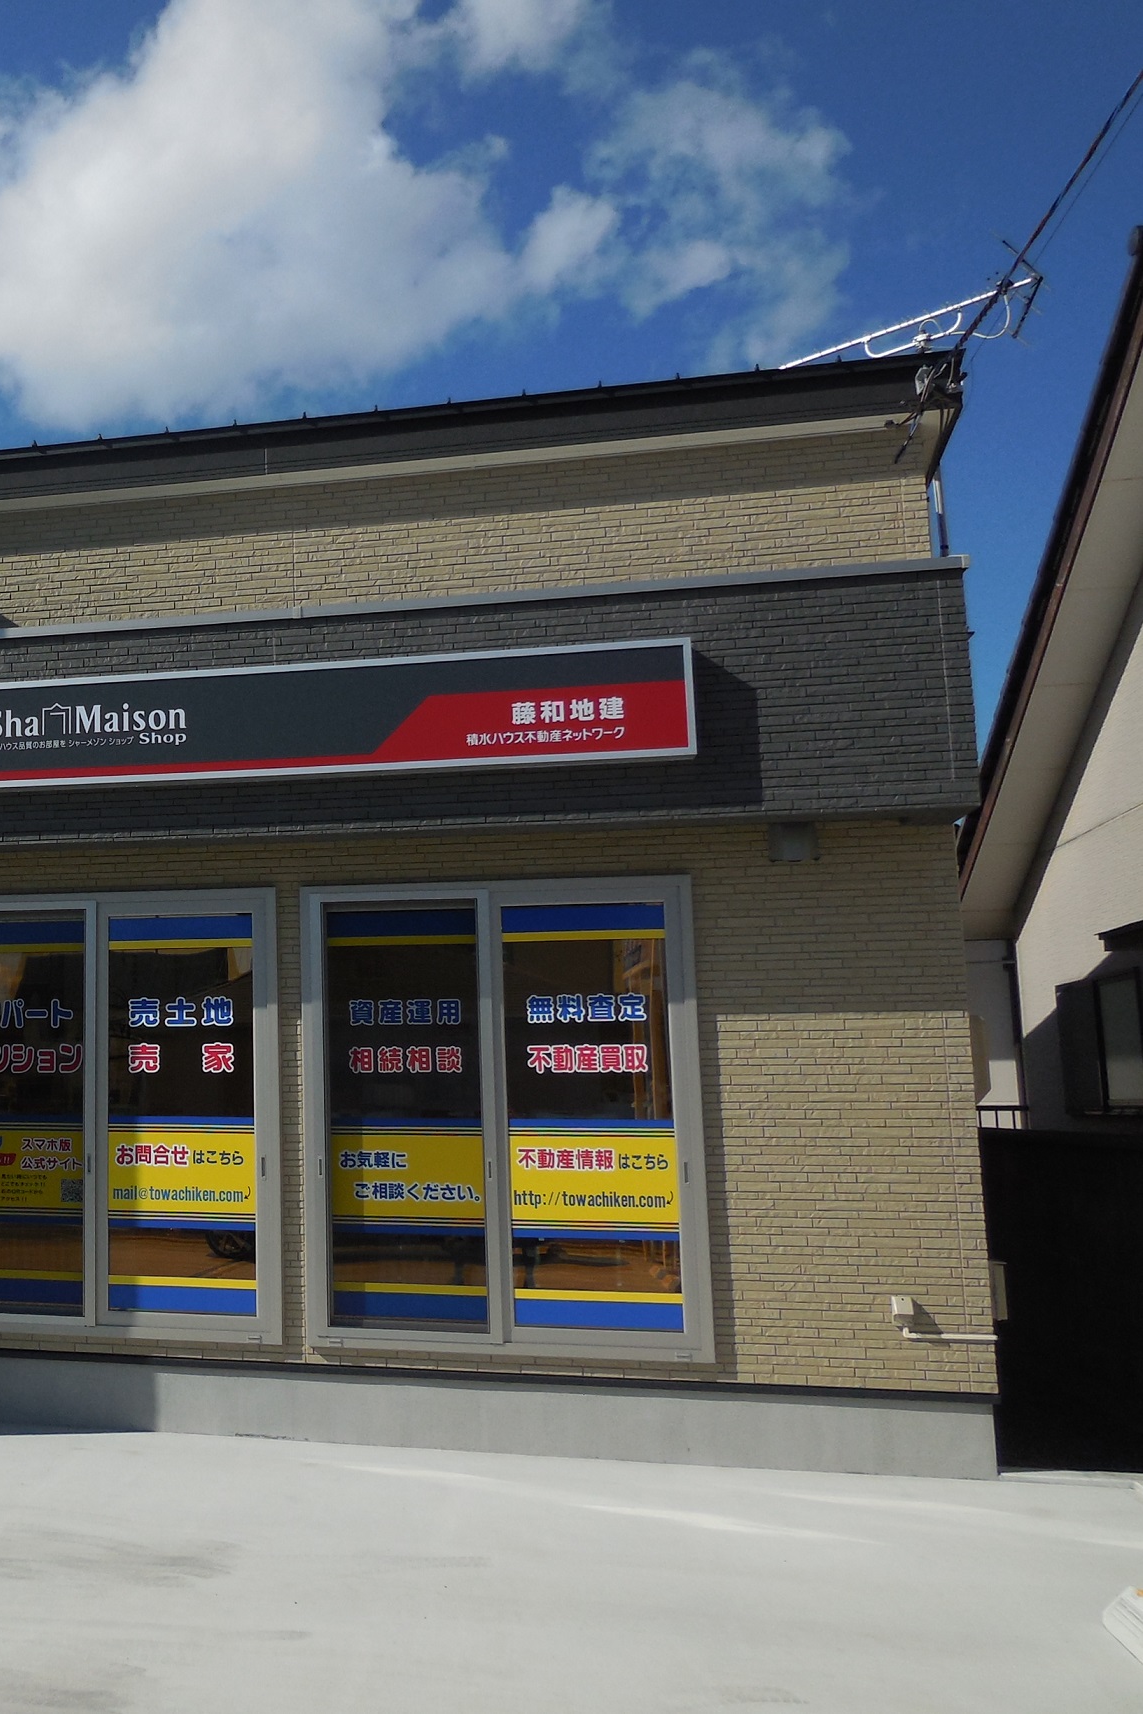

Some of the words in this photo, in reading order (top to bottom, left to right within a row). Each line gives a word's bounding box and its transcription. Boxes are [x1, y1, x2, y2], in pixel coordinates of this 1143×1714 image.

[75, 702, 187, 734] Maison
[511, 696, 625, 725] 藤和地建
[139, 732, 187, 745] Shop
[466, 726, 625, 746] 積水ハウス不動産ネットワーク
[128, 996, 233, 1027] 売土地
[349, 998, 461, 1026] 資産運用
[527, 992, 647, 1023] 無料査定
[349, 1045, 462, 1073] 相続相談
[527, 1044, 648, 1073] 不動産買取
[21, 1138, 72, 1152] スマホ版
[21, 1156, 82, 1171] 公式サイト
[339, 1150, 408, 1170] お気軽に
[112, 1185, 244, 1203] mail@towachiken.com
[354, 1182, 481, 1202] ご相談ください。
[513, 1188, 667, 1209] http://towachiken.com
